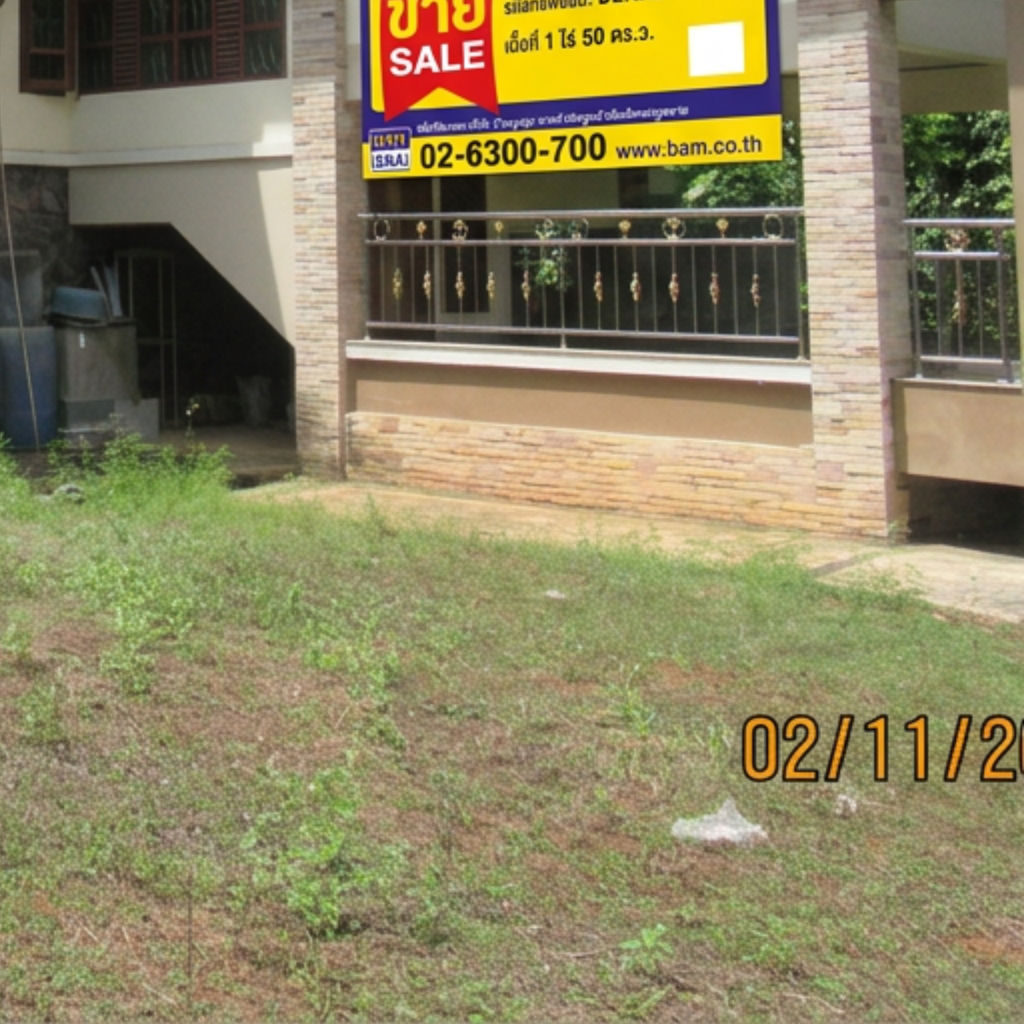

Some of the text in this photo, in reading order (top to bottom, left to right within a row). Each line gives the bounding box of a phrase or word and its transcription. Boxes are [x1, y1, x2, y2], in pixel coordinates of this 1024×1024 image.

[545, 32, 553, 50] 1
[582, 27, 605, 46] 50
[389, 39, 485, 77] SALE
[420, 133, 607, 169] 02-6300-700
[616, 136, 762, 159] www.bam.co.th
